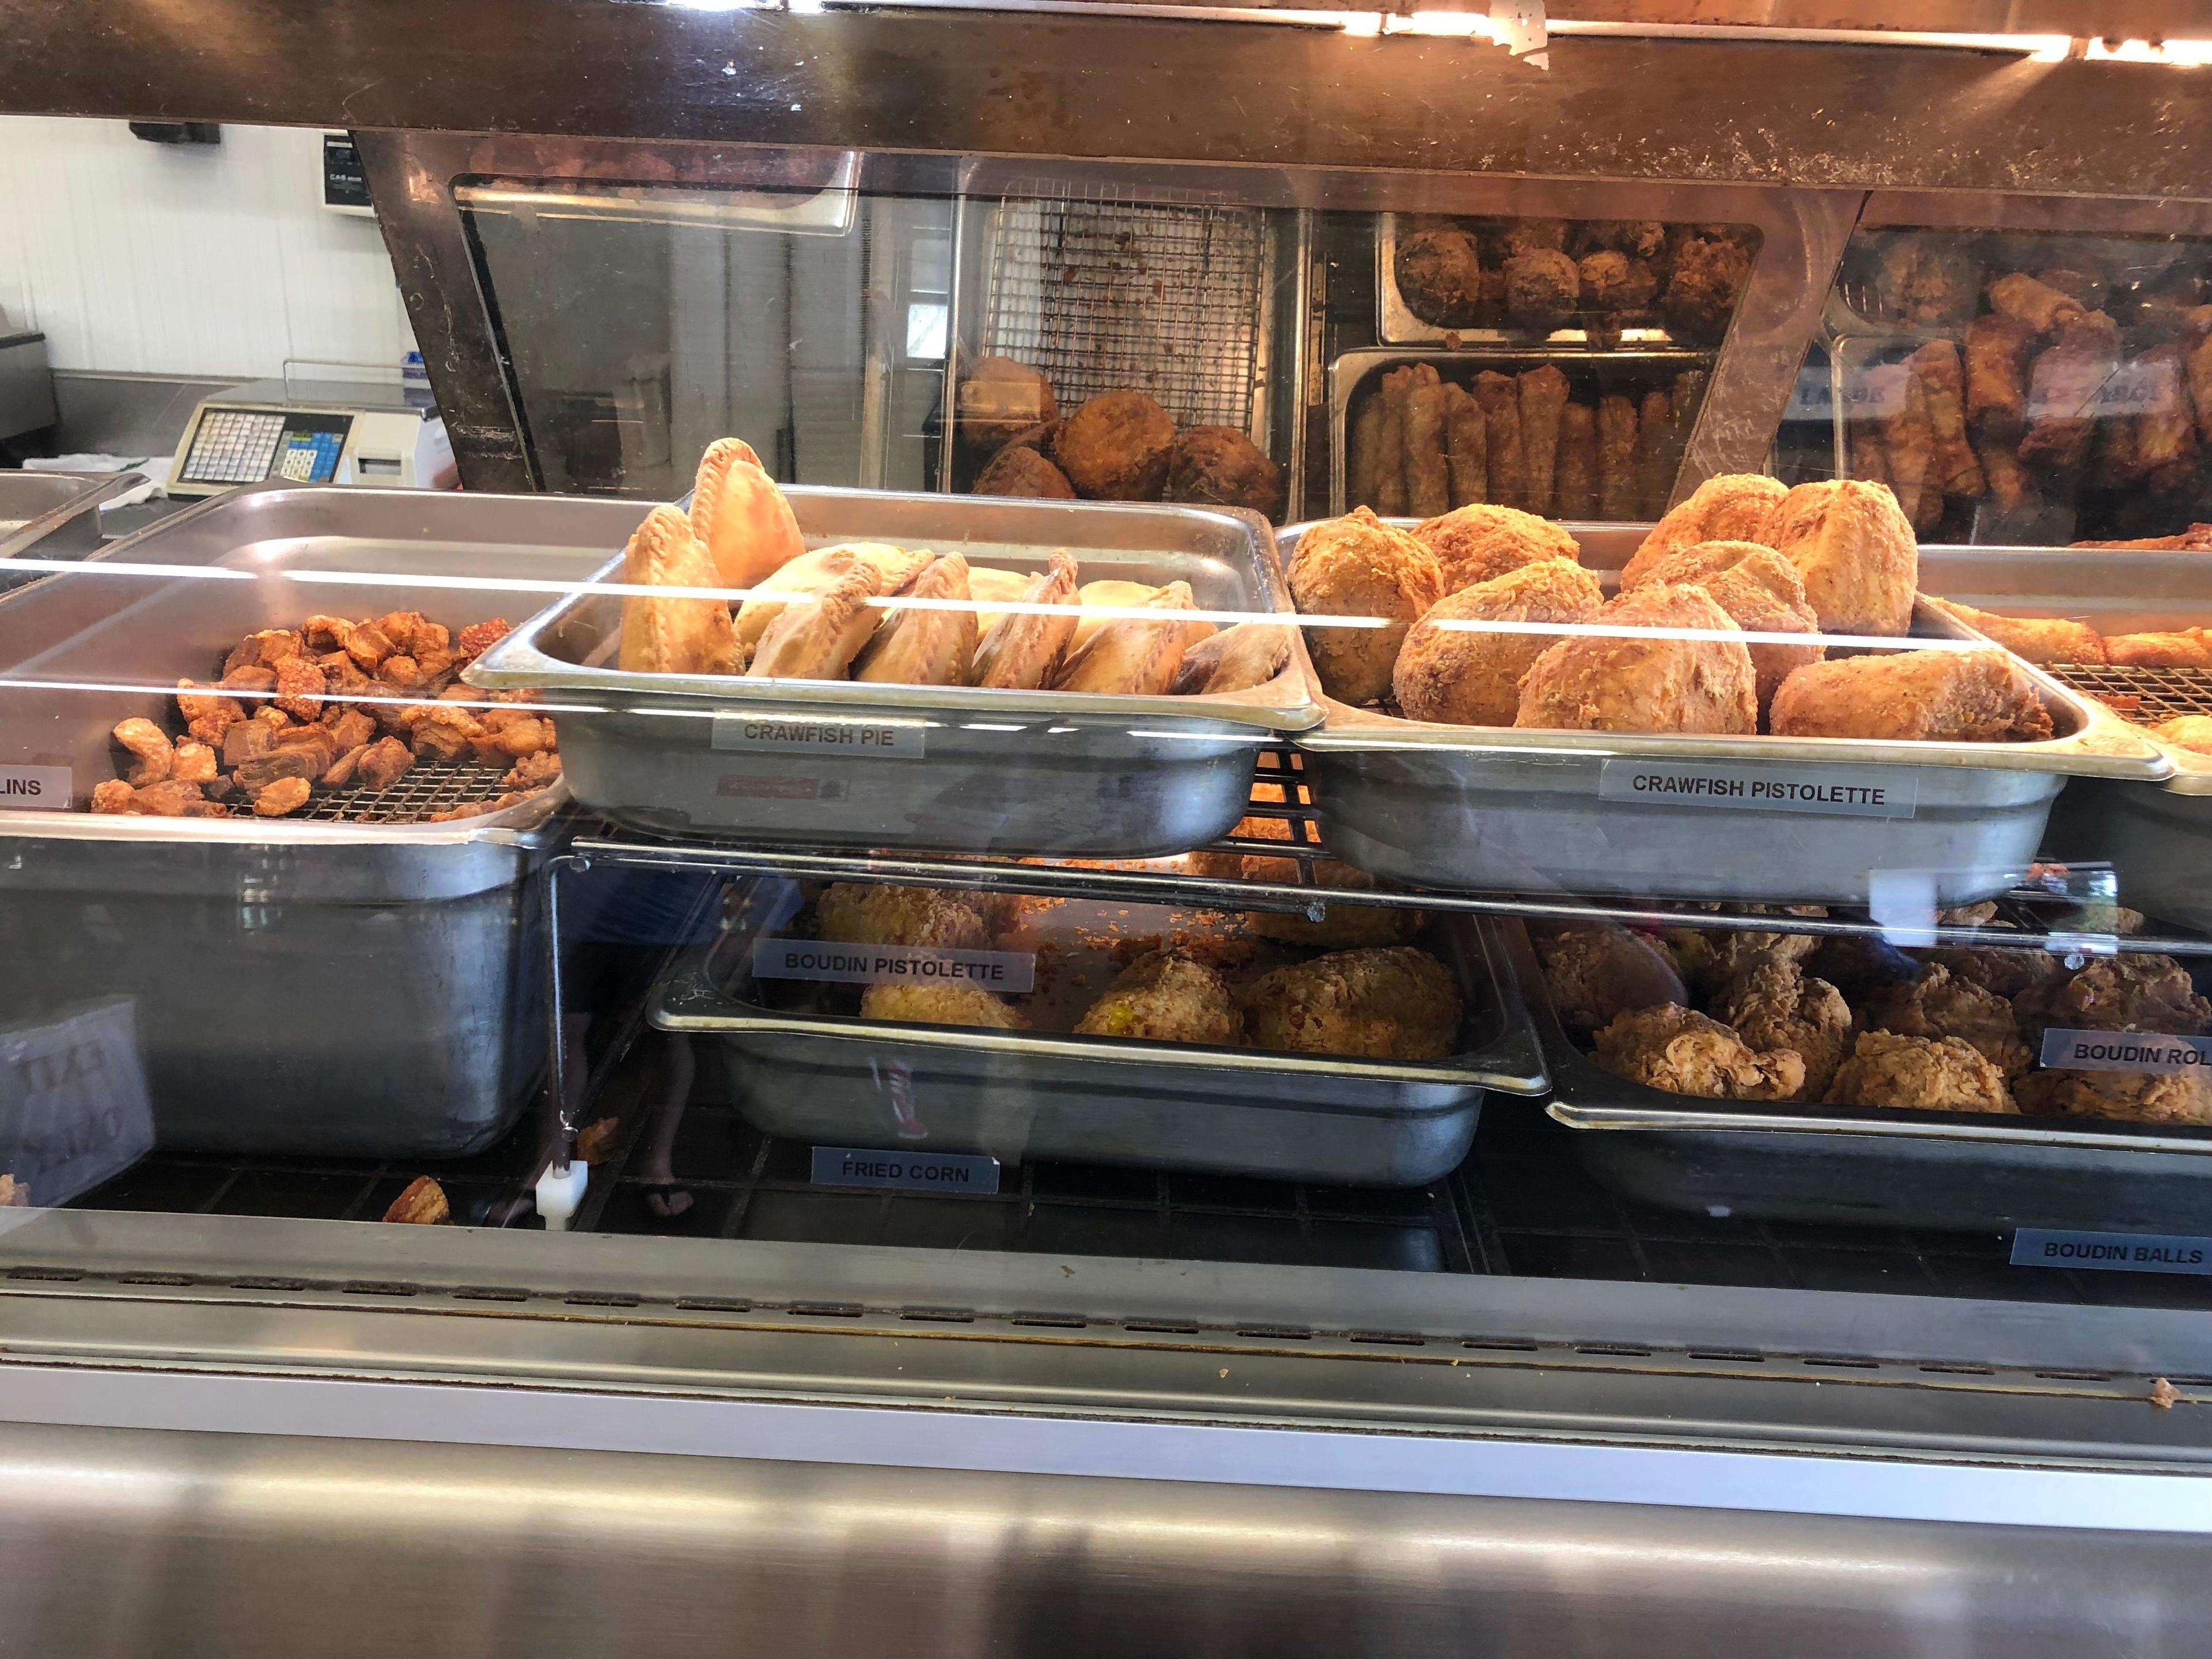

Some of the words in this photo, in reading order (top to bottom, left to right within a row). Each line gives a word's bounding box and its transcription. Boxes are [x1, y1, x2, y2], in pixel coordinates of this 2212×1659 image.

[744, 724, 853, 744] CRAWFISH
[861, 729, 894, 746] PIE
[1633, 775, 1744, 797] CRAWFISH
[1751, 781, 1885, 805] PISTOLETTE
[785, 953, 866, 972] BOUDIN
[874, 959, 1003, 980] PISTOLETTE
[2074, 1044, 2162, 1063] BOUDIN
[2166, 1048, 2212, 1066] ROL
[842, 1161, 903, 1178] FRIED
[909, 1165, 969, 1182] CORN
[2044, 1243, 2127, 1260] BOUDIN
[2134, 1247, 2203, 1264] BALLS
